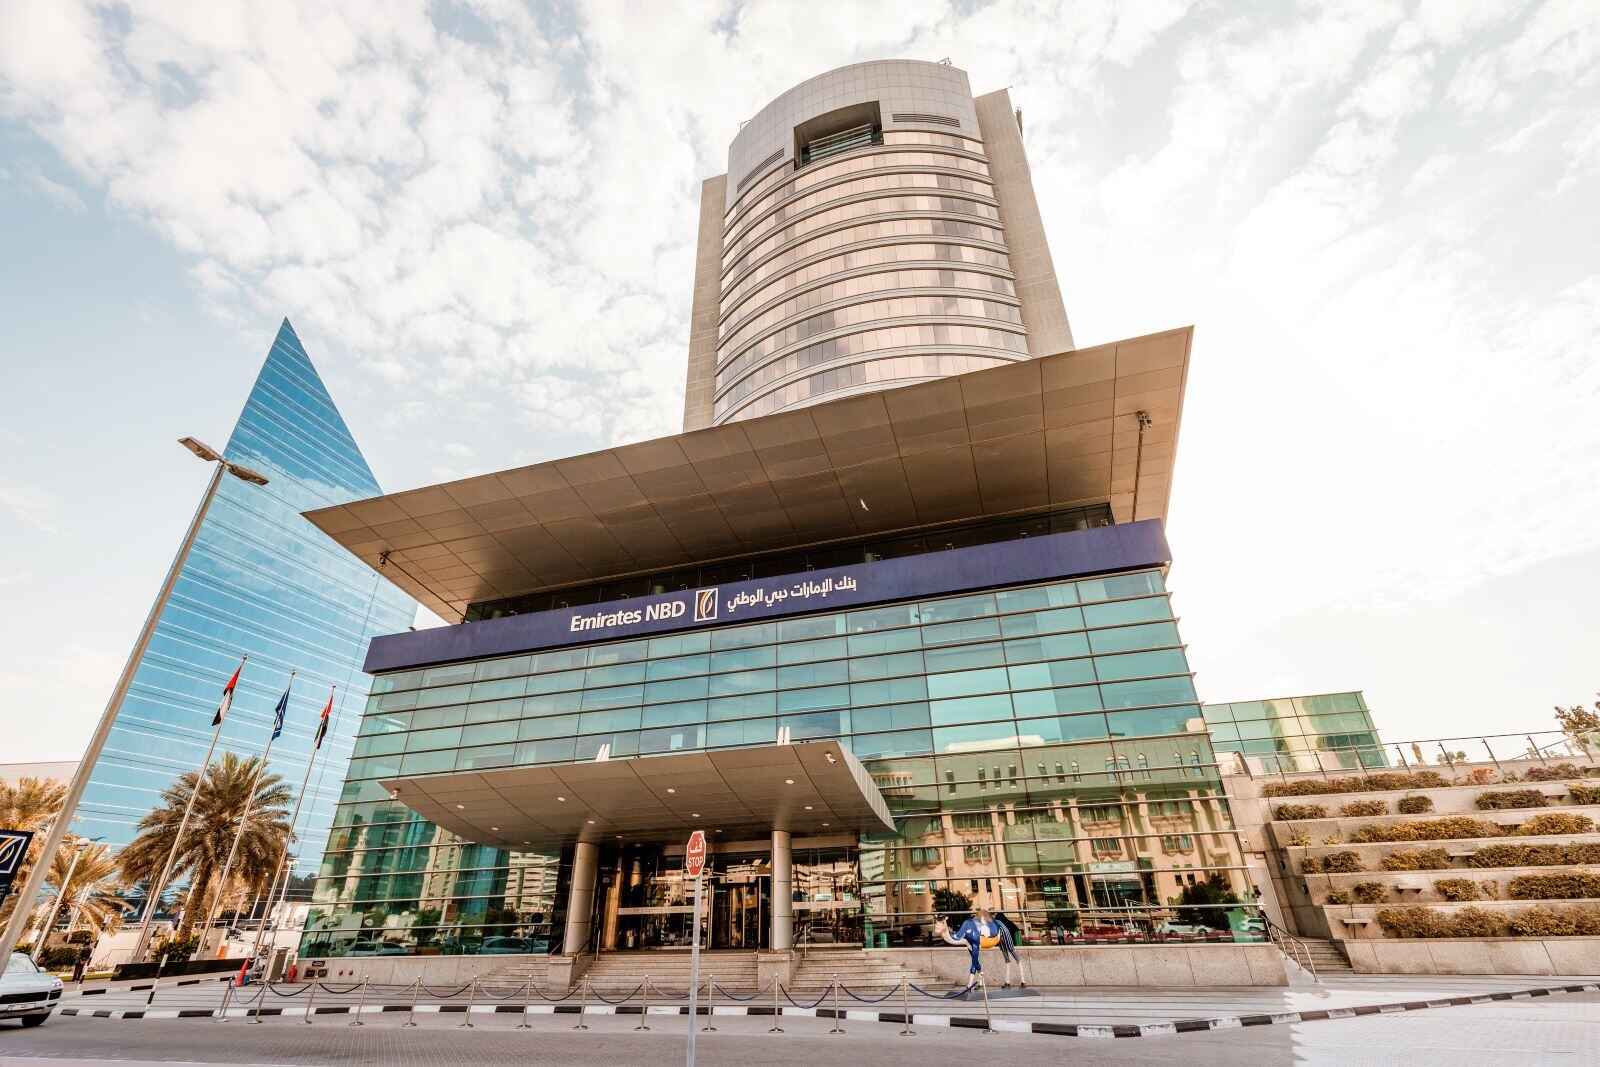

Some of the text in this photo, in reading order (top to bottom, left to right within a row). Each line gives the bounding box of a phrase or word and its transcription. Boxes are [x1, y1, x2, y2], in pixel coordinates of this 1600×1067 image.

[727, 575, 857, 612] بنك الإمارات دبي الوطني
[570, 601, 686, 632] Emirates NBD
[689, 857, 703, 868] STOP
